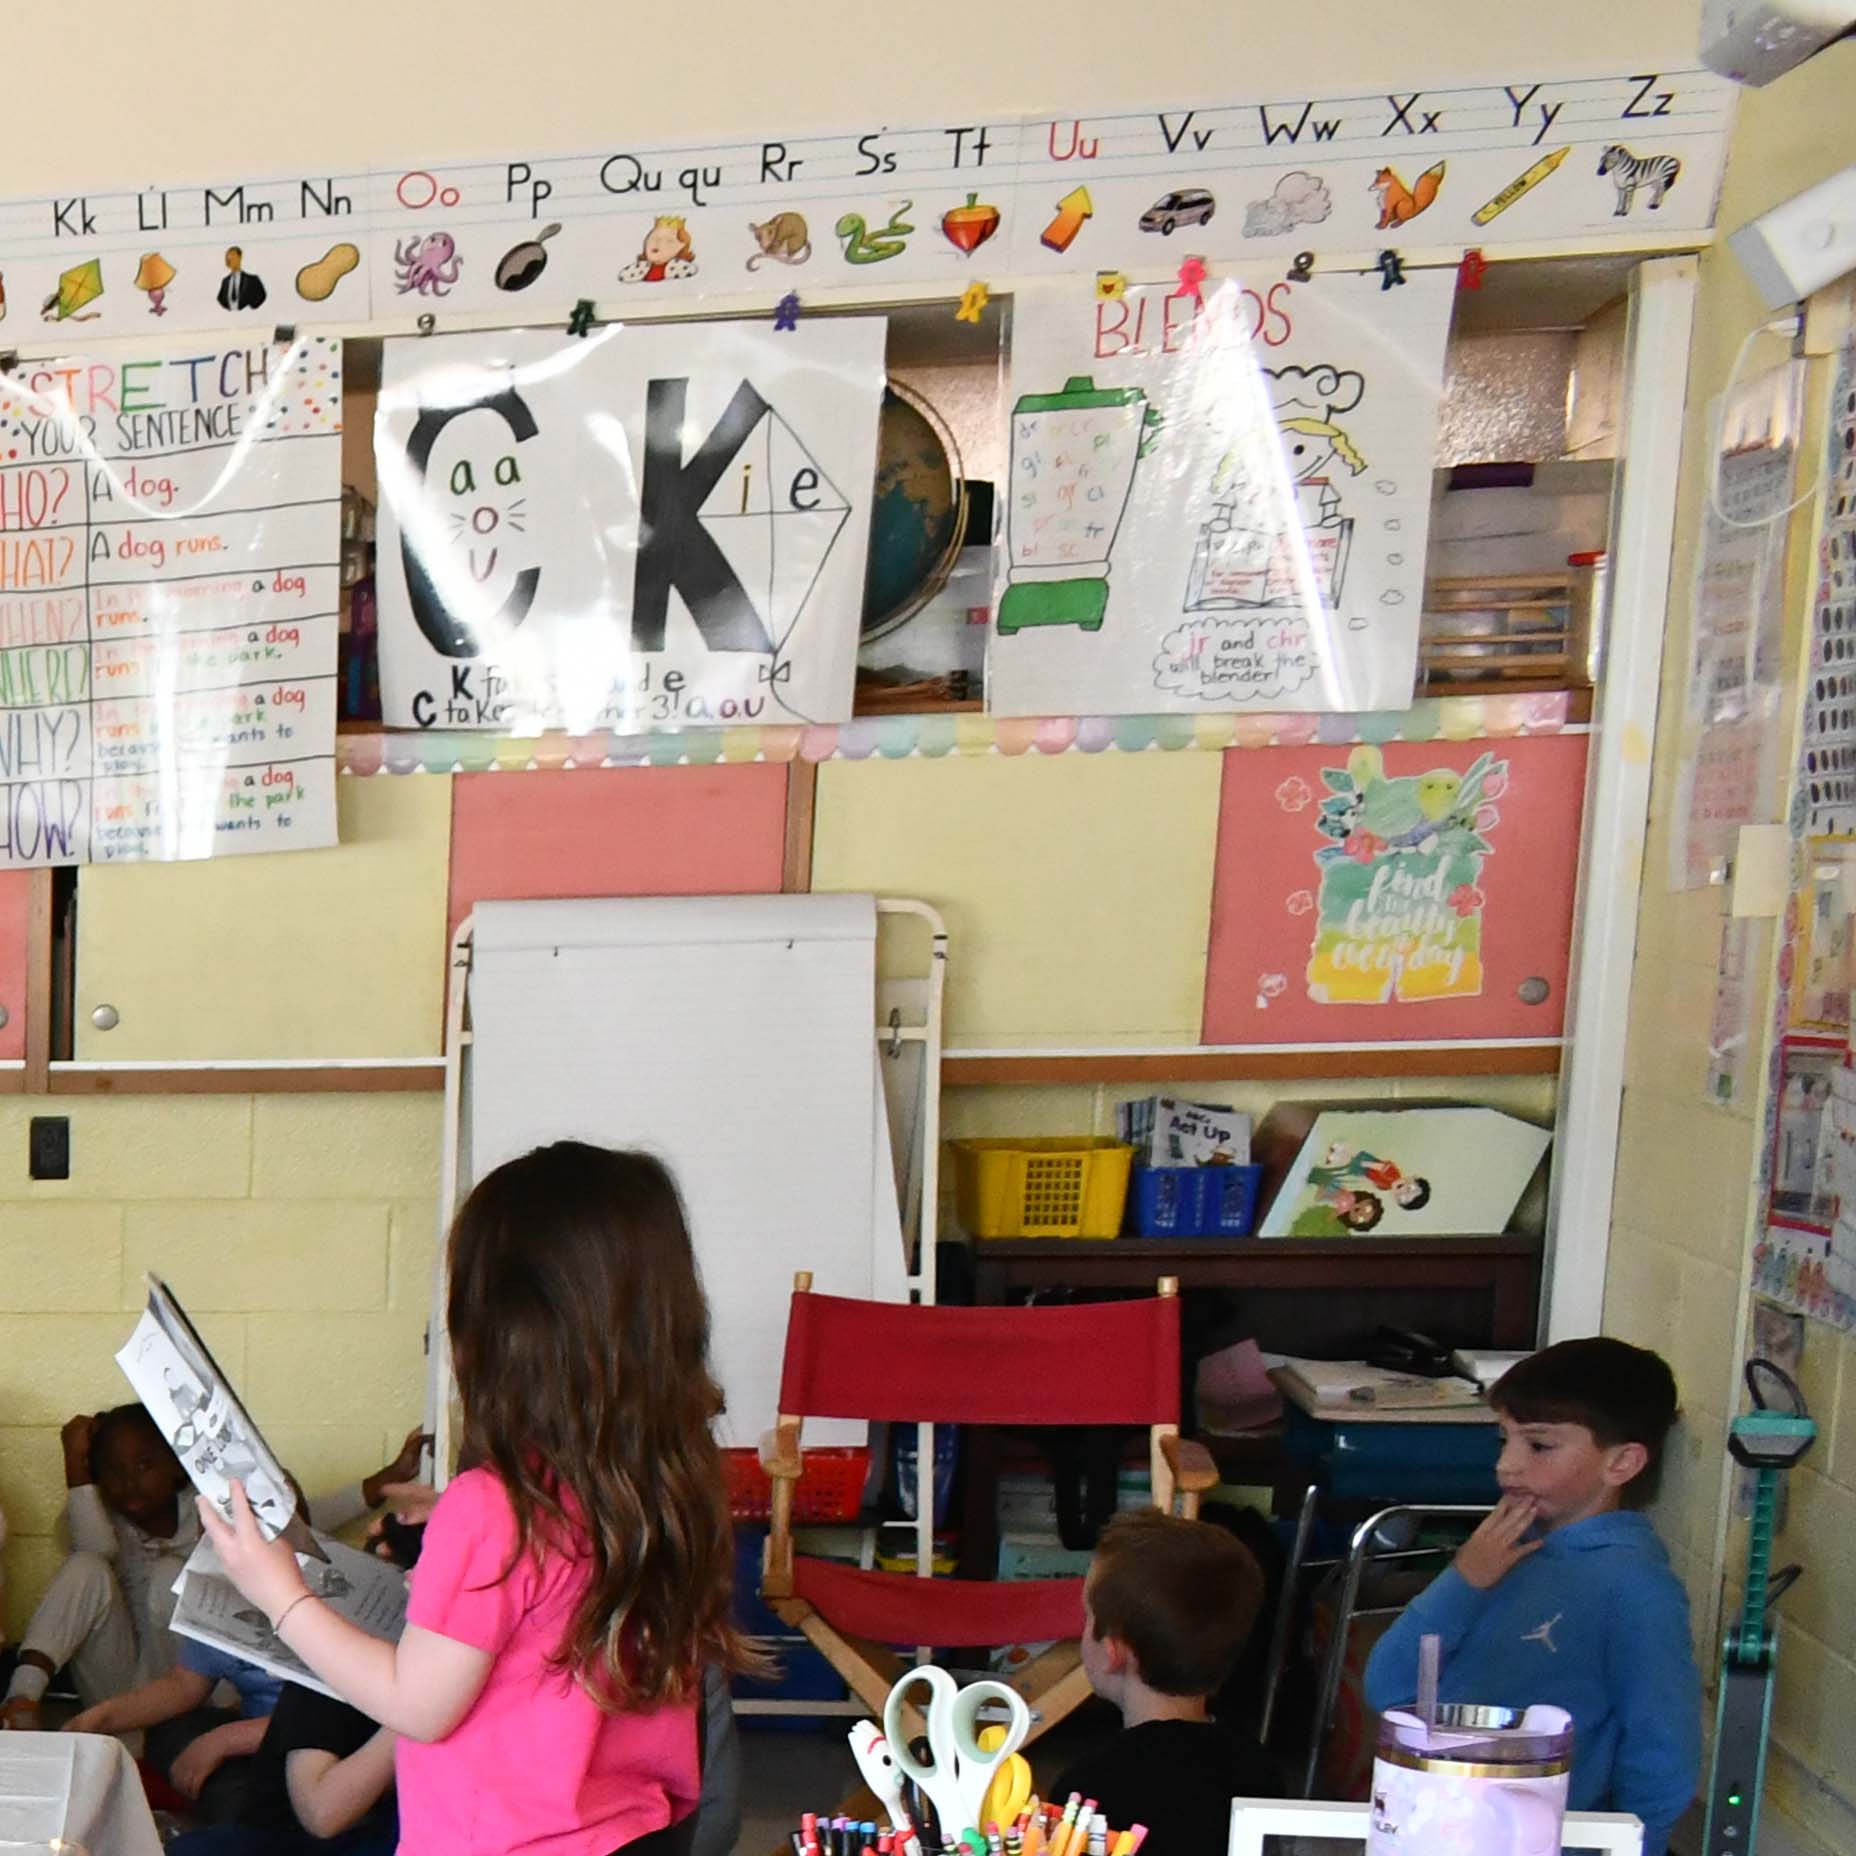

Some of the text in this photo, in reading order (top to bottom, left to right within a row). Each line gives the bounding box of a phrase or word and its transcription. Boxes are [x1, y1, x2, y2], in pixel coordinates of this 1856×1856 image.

[53, 197, 97, 238] Kk
[138, 191, 168, 232] Ll
[204, 186, 275, 227] Mm
[300, 178, 353, 218] Nn
[396, 170, 461, 209] Oo
[506, 162, 553, 219] Pp
[599, 153, 663, 194] Qu
[678, 165, 722, 207] qu
[760, 142, 804, 184] Rr
[854, 131, 898, 176] Ss
[944, 126, 992, 169] Tt
[1046, 119, 1099, 162] Uu
[1157, 111, 1215, 154] Vv
[1259, 101, 1343, 146] Ww
[1380, 92, 1444, 137] Xx
[1502, 83, 1566, 146] Yy
[1619, 74, 1677, 120] Zz
[28, 347, 270, 419] STRETCH
[115, 403, 242, 453] SENTENCE
[92, 476, 114, 503] A
[91, 531, 112, 562] A
[117, 531, 166, 568] dog
[1220, 630, 1255, 652] and
